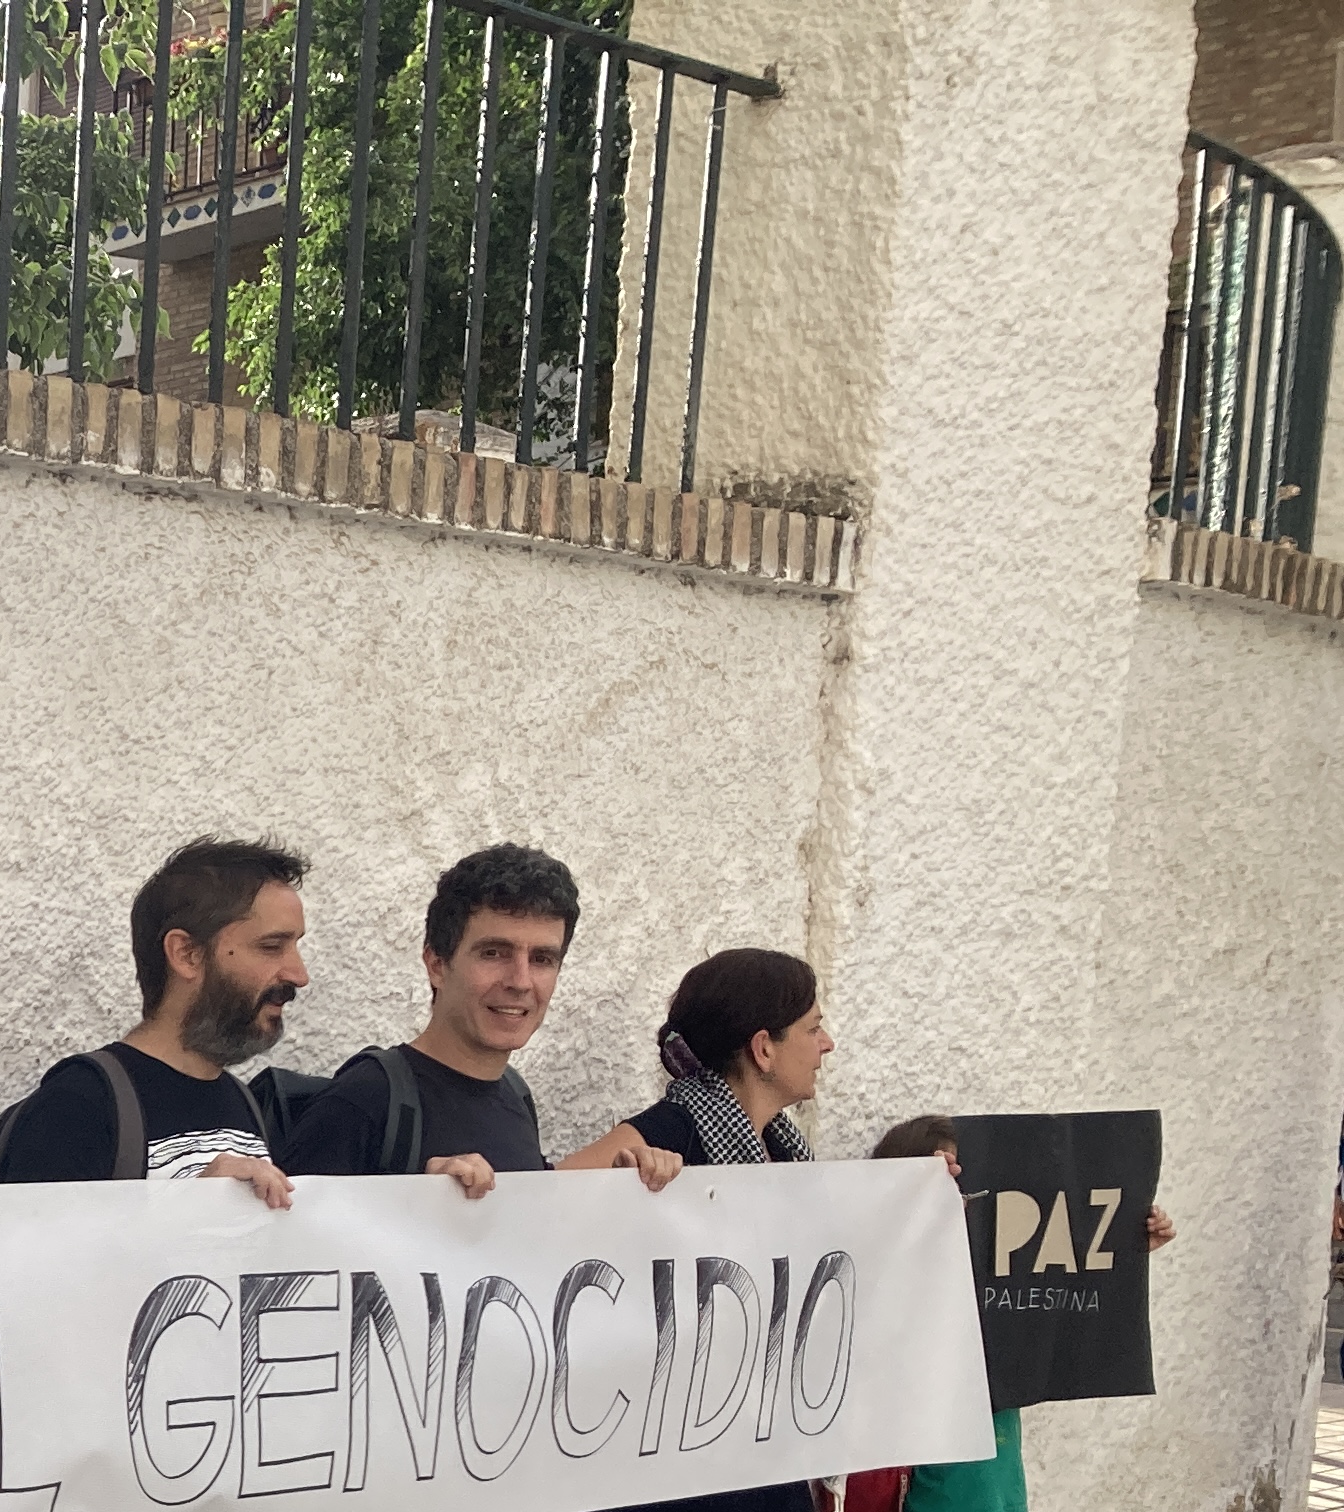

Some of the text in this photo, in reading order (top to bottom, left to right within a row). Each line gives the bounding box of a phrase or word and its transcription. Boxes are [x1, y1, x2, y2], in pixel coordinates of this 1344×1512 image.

[995, 1188, 1122, 1277] PAZ
[984, 1286, 1101, 1312] PALESTINA
[127, 1250, 857, 1506] GENOCIDIO
